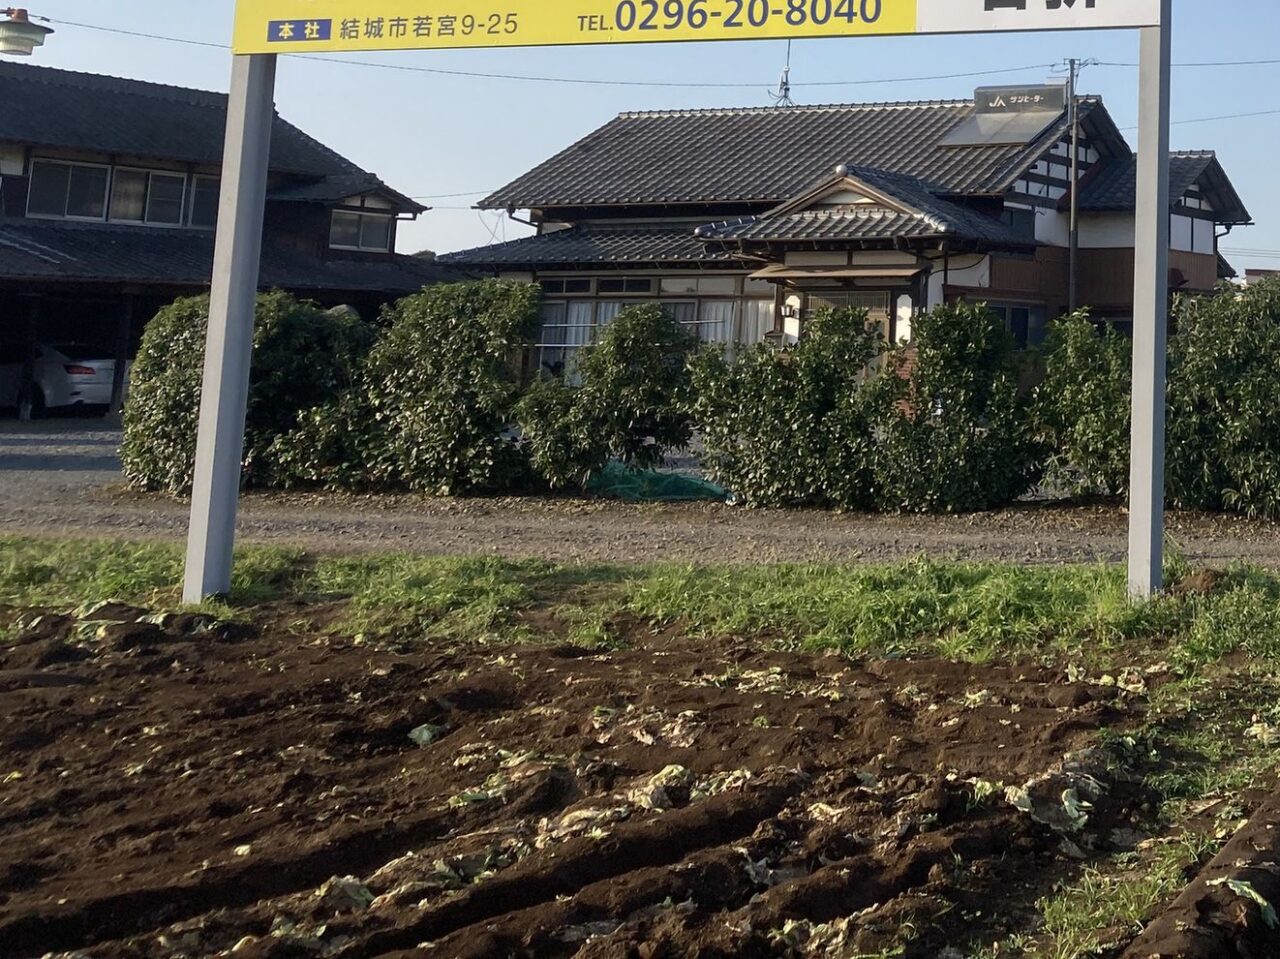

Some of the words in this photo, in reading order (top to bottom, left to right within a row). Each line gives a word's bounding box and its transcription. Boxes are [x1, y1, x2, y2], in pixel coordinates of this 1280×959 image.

[278, 21, 321, 40] 本社
[339, 13, 519, 40] 結城市若宮9-25
